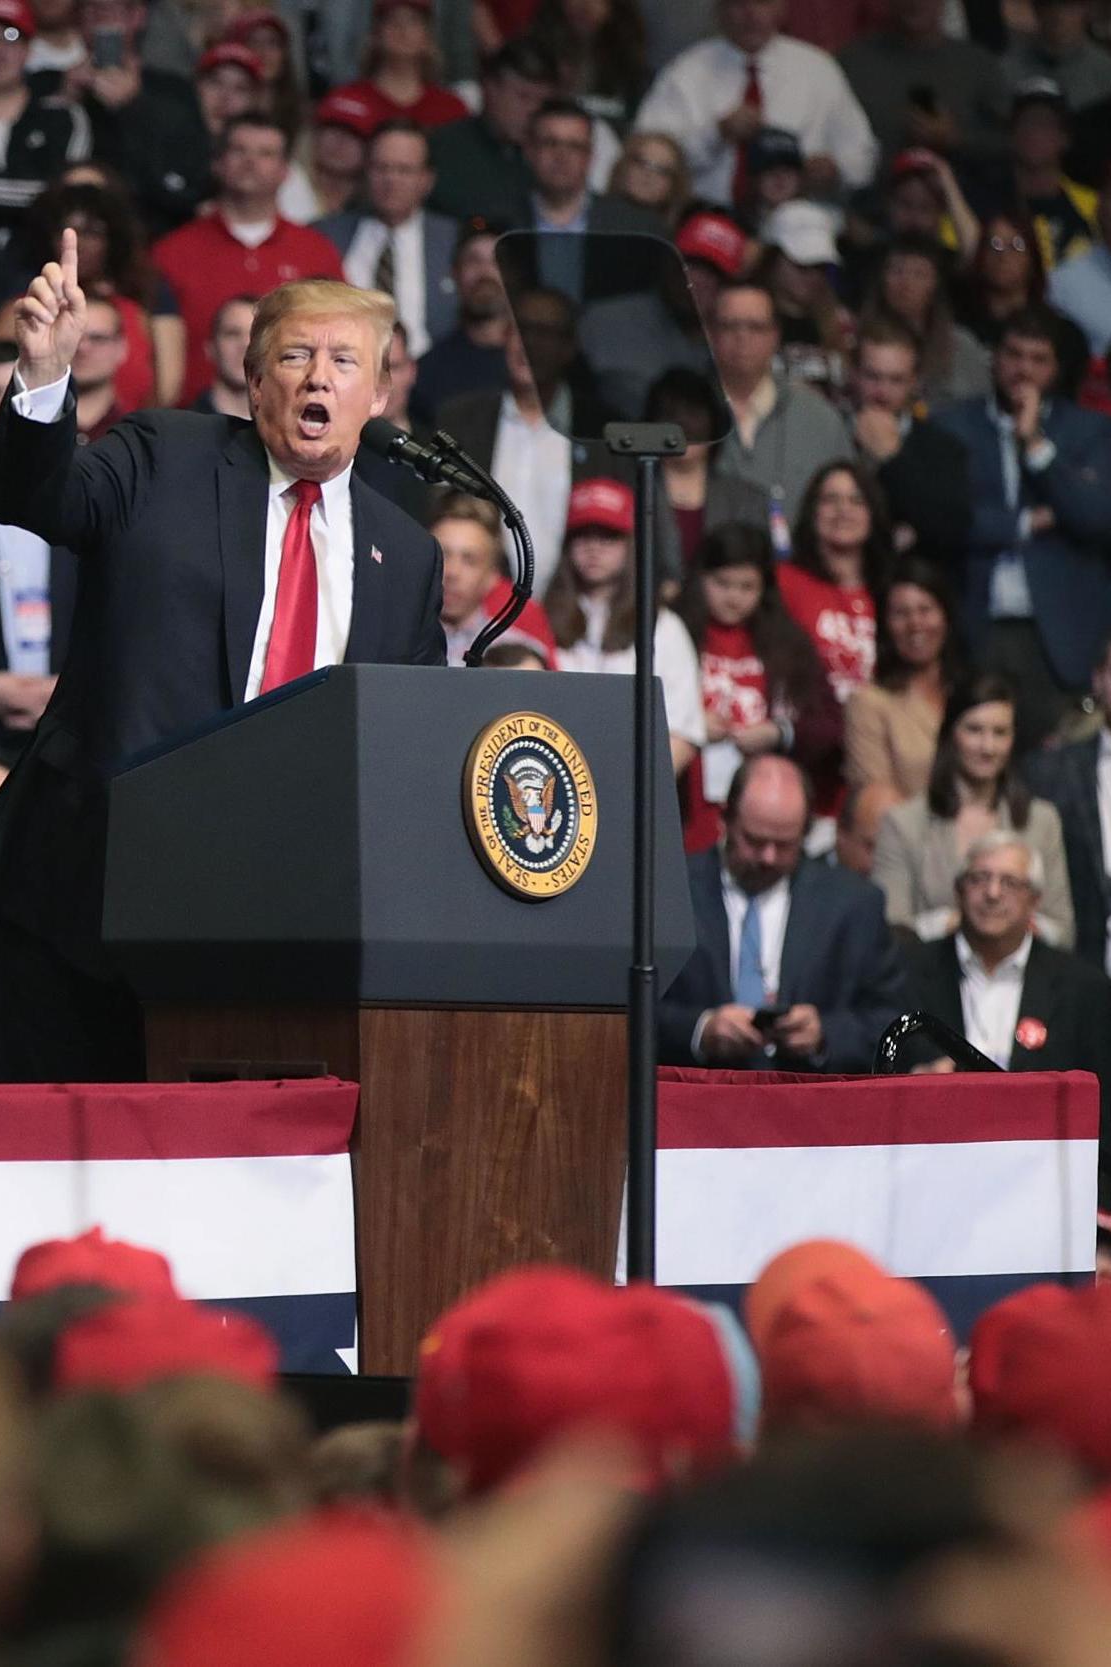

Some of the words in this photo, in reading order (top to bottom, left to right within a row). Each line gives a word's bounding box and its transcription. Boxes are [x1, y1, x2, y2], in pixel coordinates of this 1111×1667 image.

[529, 721, 540, 733] OF
[543, 724, 559, 743] THE
[477, 718, 526, 798] PRESIDENT
[562, 743, 593, 817] UNITED
[479, 806, 490, 832] THE
[487, 832, 497, 850] OF
[496, 848, 529, 887] SEAL
[551, 833, 590, 888] STATES
